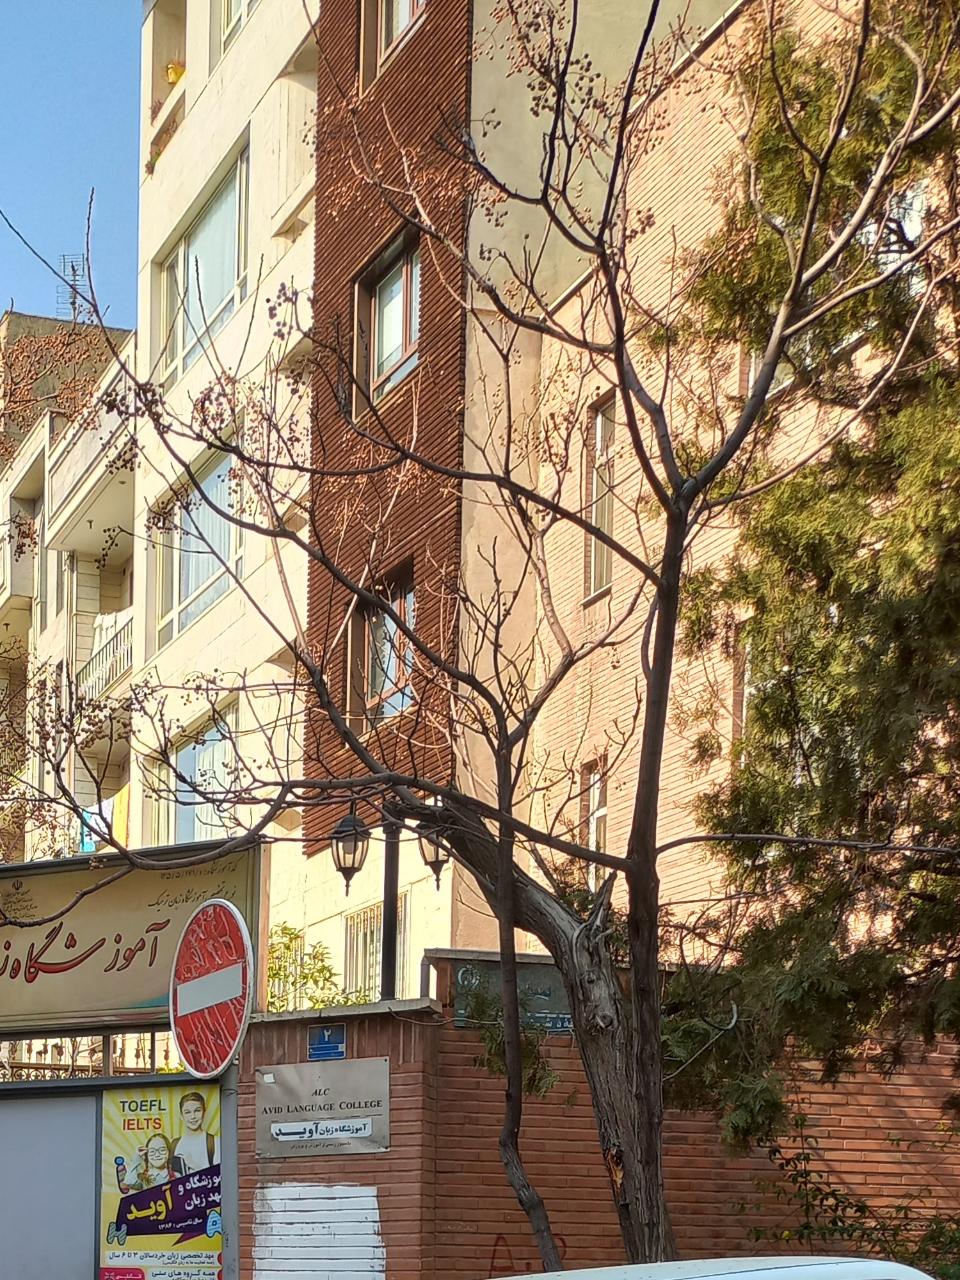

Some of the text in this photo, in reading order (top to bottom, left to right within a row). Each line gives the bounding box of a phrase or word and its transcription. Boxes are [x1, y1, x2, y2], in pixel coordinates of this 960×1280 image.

[10, 919, 171, 985] آموزشگاه
[311, 1088, 330, 1097] ALC
[120, 1099, 167, 1113] TOEFL
[261, 1099, 383, 1116] AVID LANGUAGE COLLEGE
[122, 1117, 162, 1131] IELTS
[274, 1121, 368, 1139] آموزشگاه زبان آوید
[178, 1184, 184, 1196] و
[126, 1185, 172, 1221] آوید
[184, 1192, 206, 1210] زبان
[108, 1252, 120, 1261] سال
[139, 1251, 166, 1261] خردسالان
[167, 1251, 179, 1261] زبان
[180, 1252, 204, 1261] تخصصی
[170, 1270, 181, 1278] های
[183, 1269, 201, 1279] گروه
